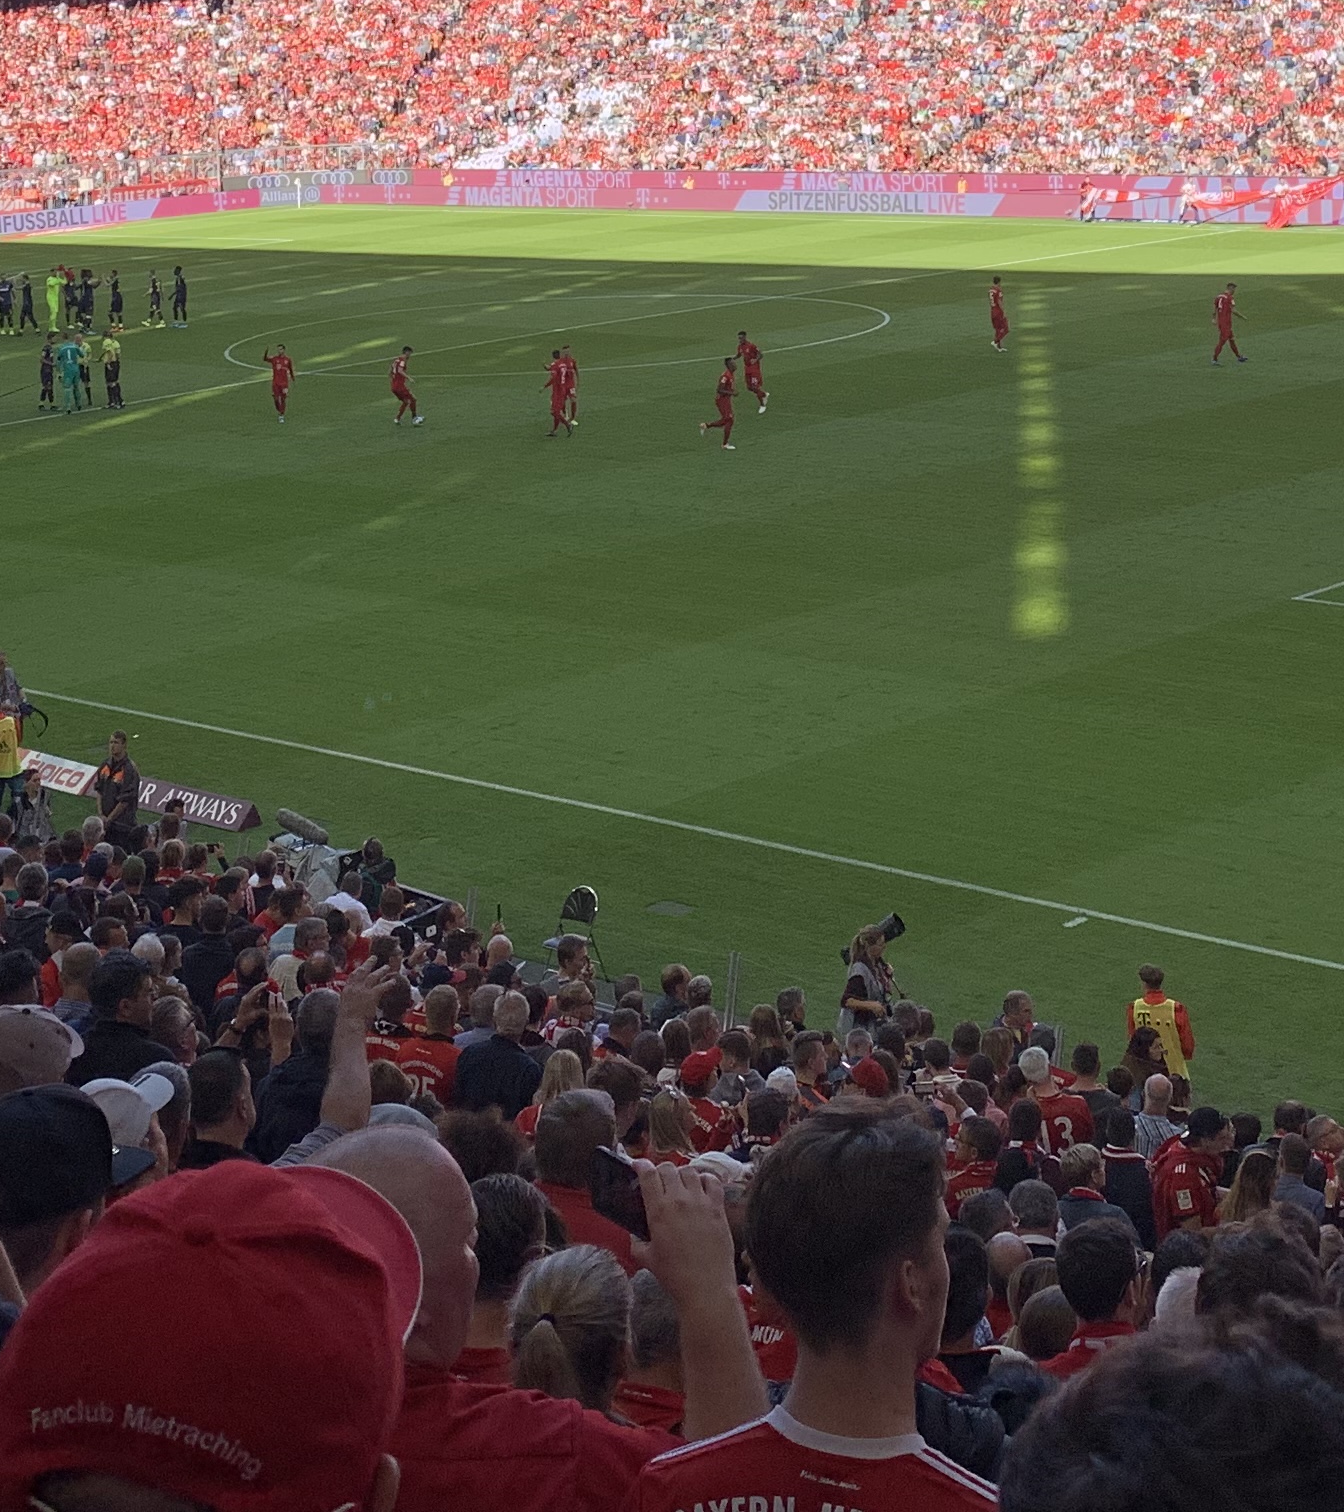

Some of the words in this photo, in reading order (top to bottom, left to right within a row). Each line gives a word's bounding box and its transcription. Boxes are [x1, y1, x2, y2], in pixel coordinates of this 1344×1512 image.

[511, 171, 583, 187] MAGENTA
[586, 171, 633, 188] SPORT
[801, 173, 890, 192] MAGNTA
[890, 174, 948, 192] SPORT
[262, 189, 302, 203] Allianz
[465, 188, 543, 207] MAGENTA
[546, 188, 597, 208] SPORT
[768, 192, 924, 213] SPITZENFUSSBALL
[927, 194, 966, 214] LIVE
[92, 203, 127, 223] LIVE
[158, 788, 243, 825] AIRWAYS
[30, 1397, 114, 1433] Fanclub
[122, 1403, 263, 1481] Mietraching
